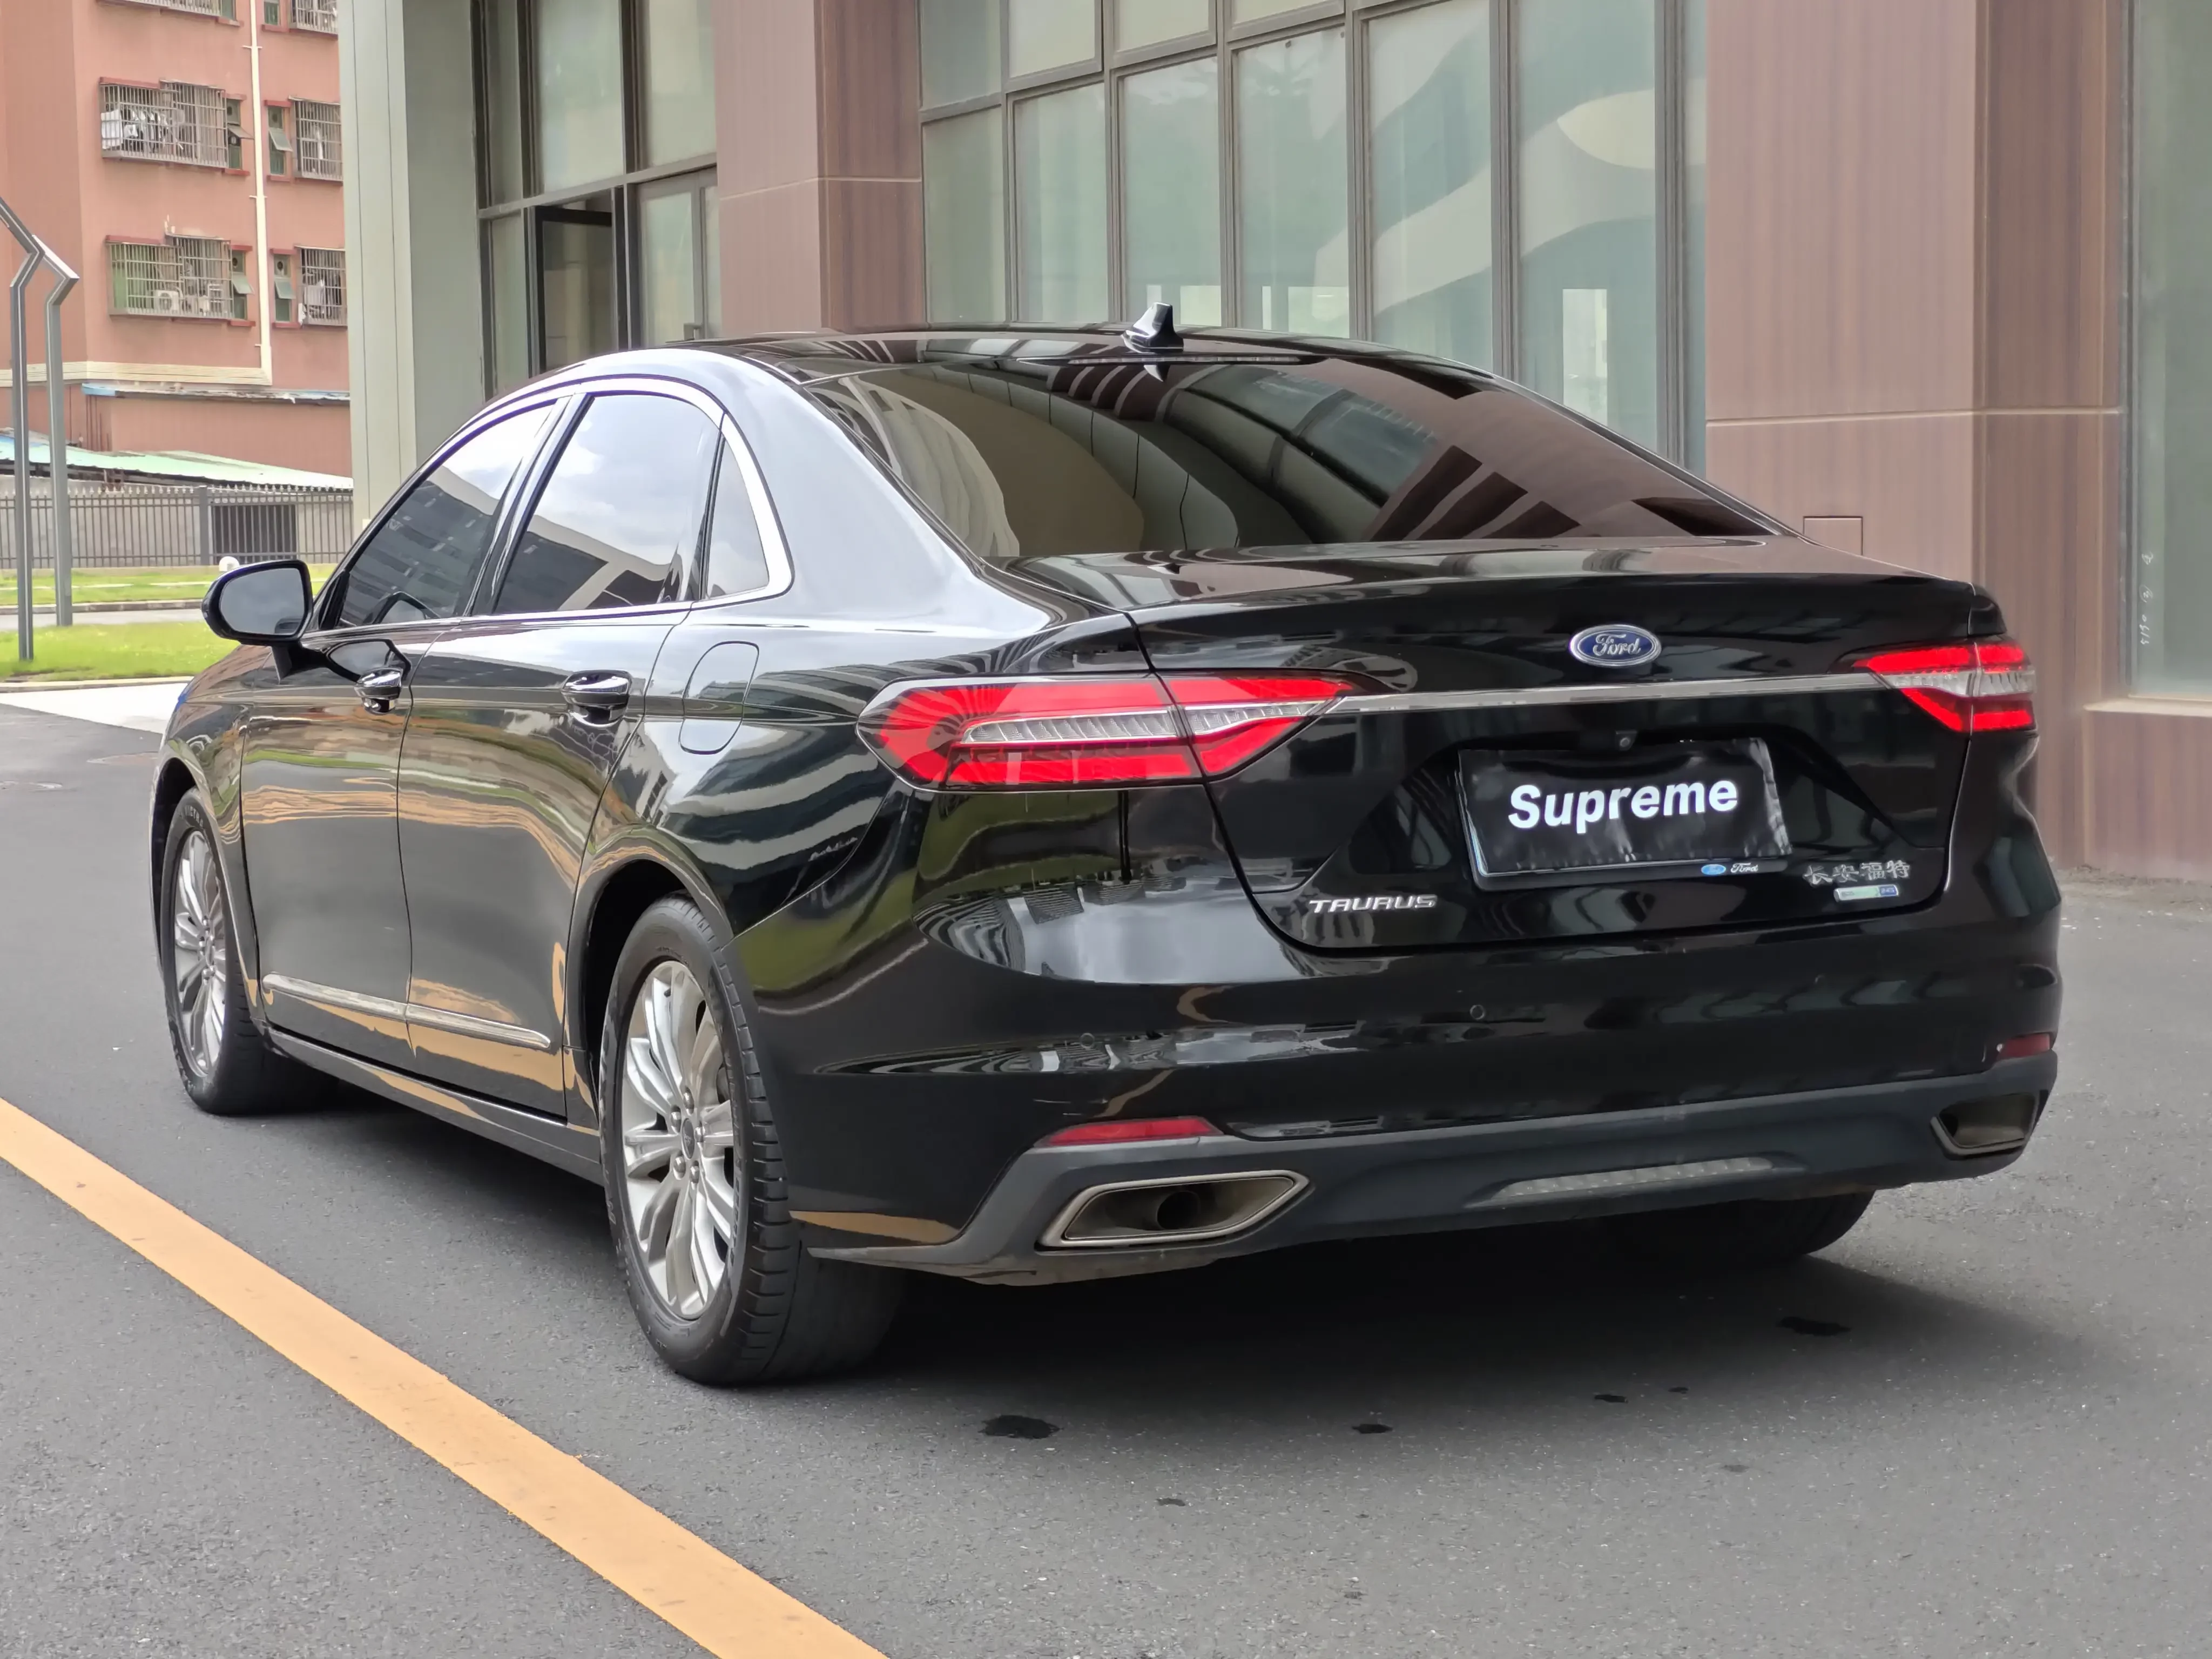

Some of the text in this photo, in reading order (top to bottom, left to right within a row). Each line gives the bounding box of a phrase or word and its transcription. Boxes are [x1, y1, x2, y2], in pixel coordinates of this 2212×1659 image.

[1592, 633, 1641, 656] Ford
[1508, 779, 1738, 834] Supreme
[1730, 862, 1758, 873] Ford
[1803, 860, 1911, 885] 长安福特
[1309, 894, 1438, 913] TAURUS
